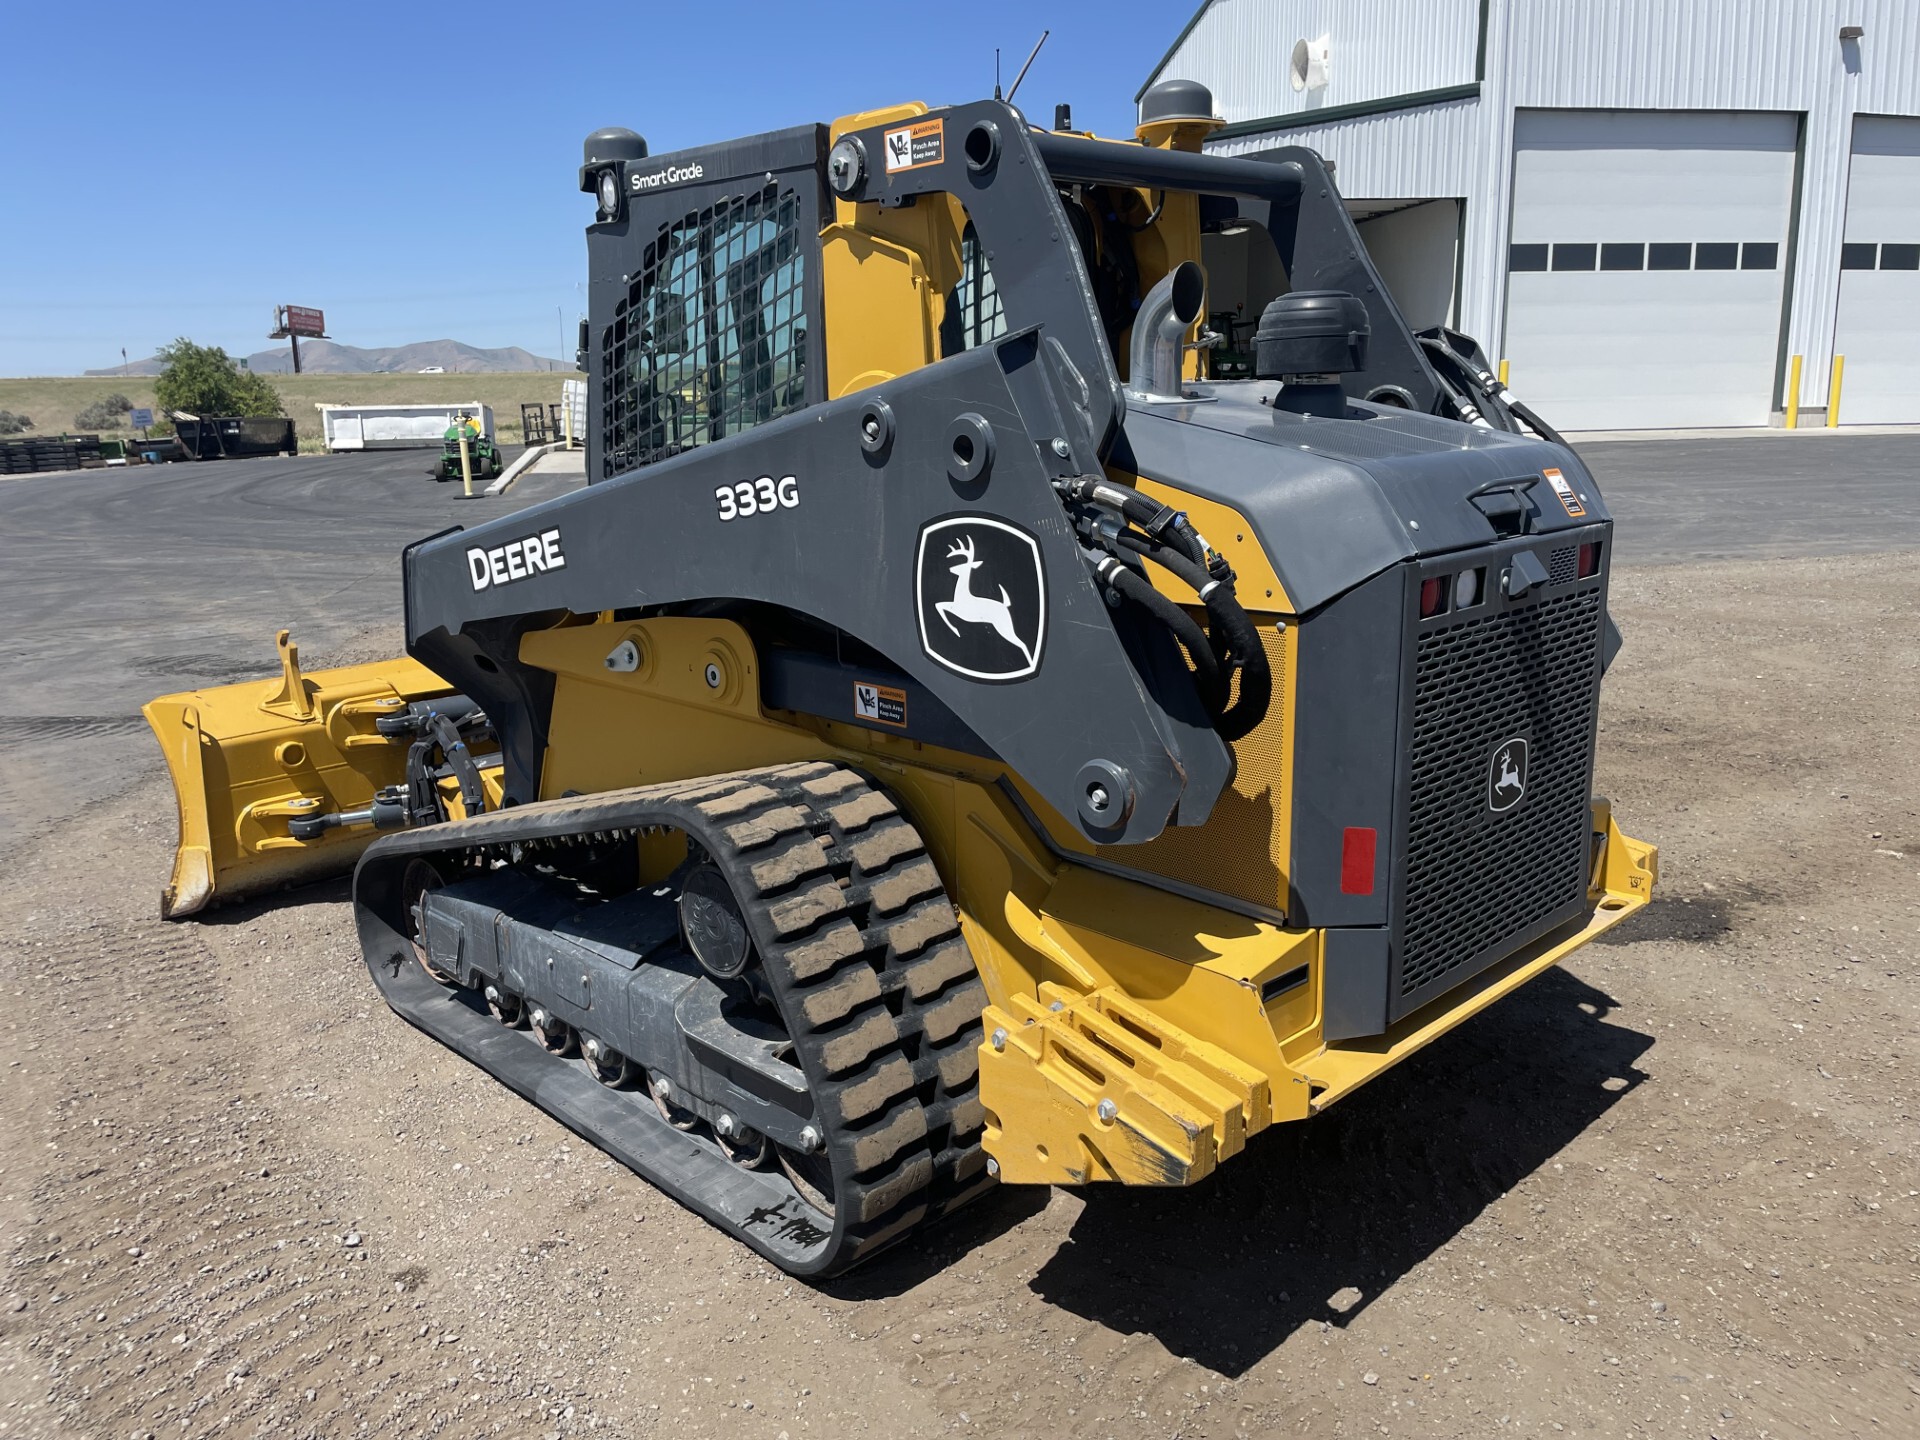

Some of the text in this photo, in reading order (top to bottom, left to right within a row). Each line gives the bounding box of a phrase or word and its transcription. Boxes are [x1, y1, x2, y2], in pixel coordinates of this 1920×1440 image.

[913, 142, 927, 150] Pinch
[631, 162, 703, 190] SmartGrade
[715, 476, 800, 521] 333G
[467, 528, 565, 591] DEERE
